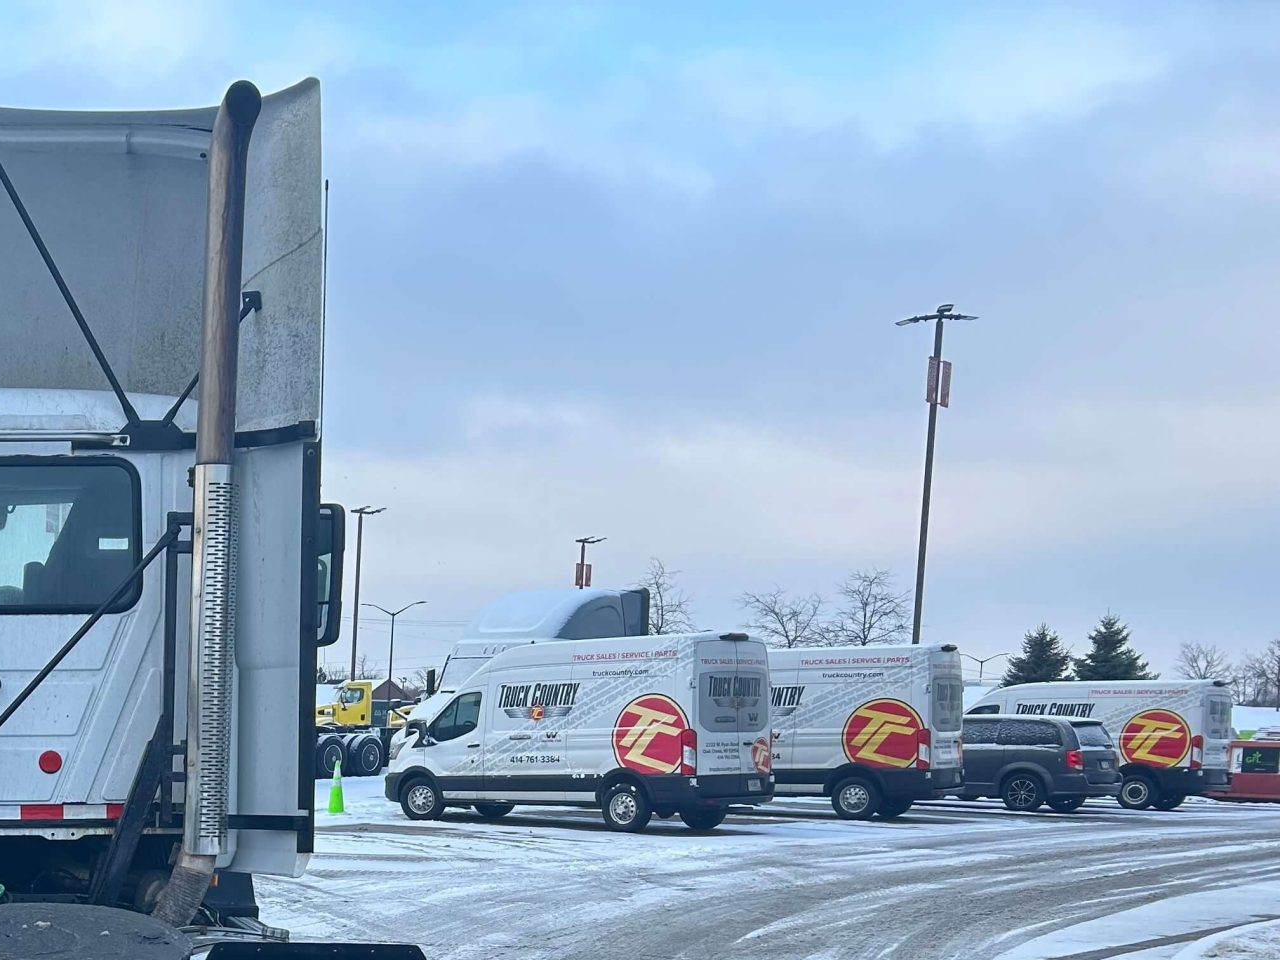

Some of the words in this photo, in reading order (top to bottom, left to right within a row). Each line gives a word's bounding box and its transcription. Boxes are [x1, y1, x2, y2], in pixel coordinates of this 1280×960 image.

[621, 651, 649, 659] SERVICE
[655, 649, 678, 657] PARTS
[592, 668, 649, 676] truckcountry.com
[498, 685, 532, 708] TRUCK
[531, 683, 580, 706] COUNTRY
[708, 676, 732, 697] TRUCK
[1016, 704, 1048, 716] TRUCK
[1048, 703, 1095, 718] COUNTRY
[619, 703, 685, 774] TC
[849, 708, 917, 768] TC
[1127, 716, 1185, 765] TC
[510, 755, 560, 763] 414-761-3384
